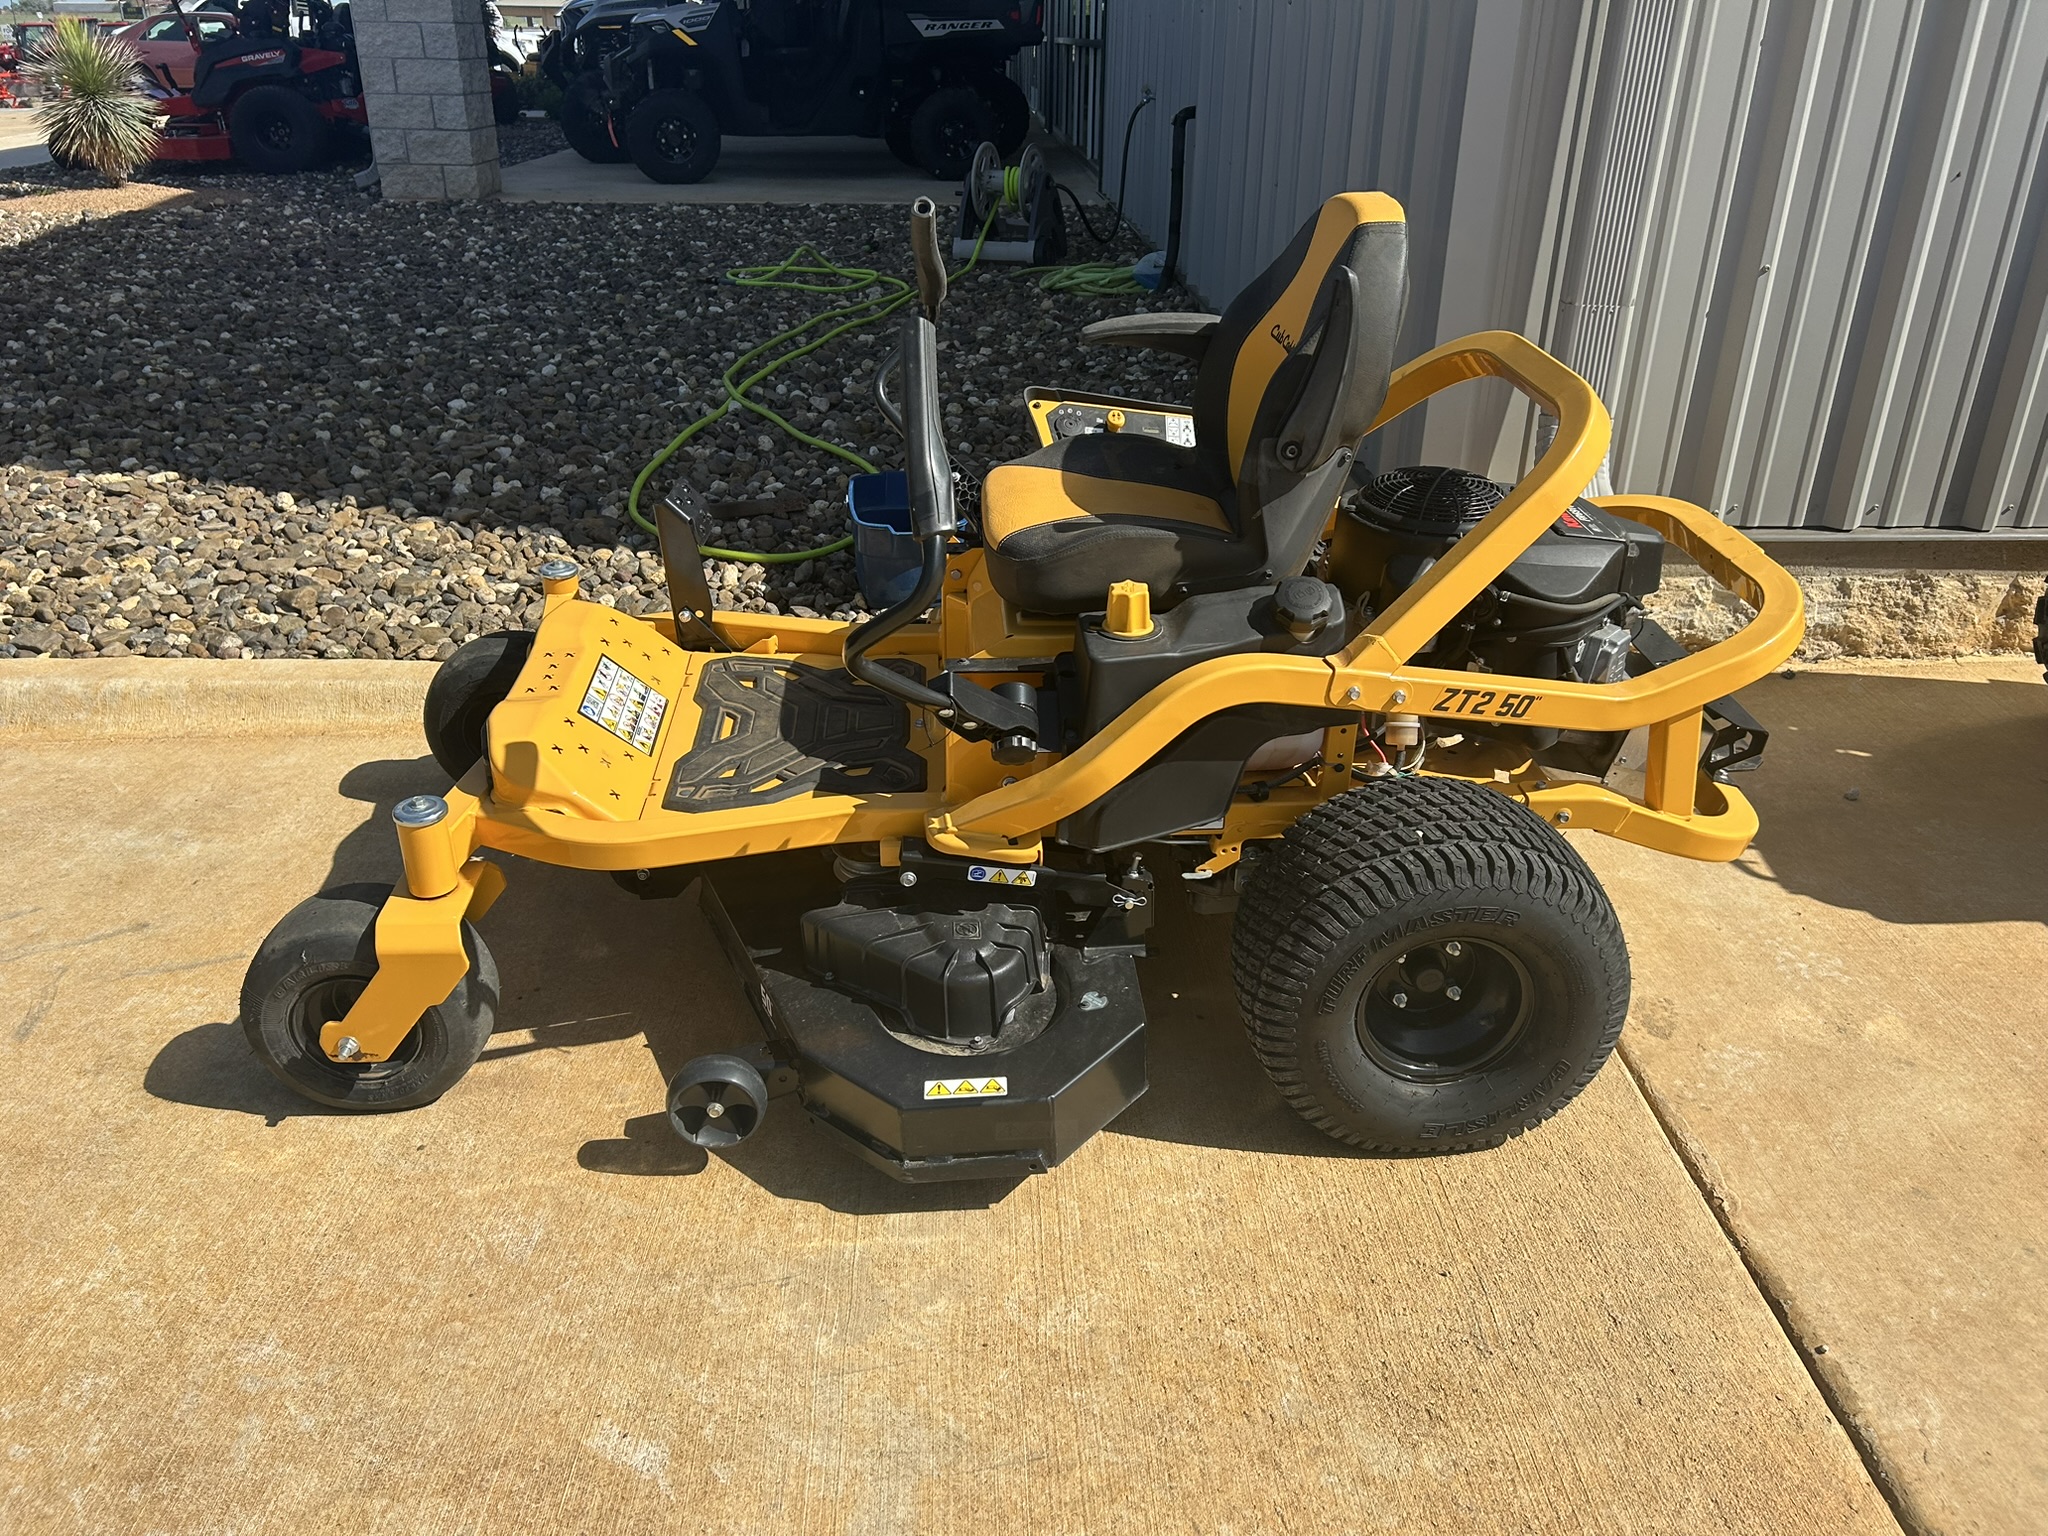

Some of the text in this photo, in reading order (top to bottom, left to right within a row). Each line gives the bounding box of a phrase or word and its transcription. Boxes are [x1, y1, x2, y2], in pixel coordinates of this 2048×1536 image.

[683, 15, 710, 25] 1000
[924, 21, 993, 31] RANGER
[241, 50, 281, 62] GRAVELY
[1433, 688, 1543, 718] ZT2 50"
[1318, 906, 1520, 1014] TURF MASTER
[1420, 1059, 1572, 1138] CARLISLE
